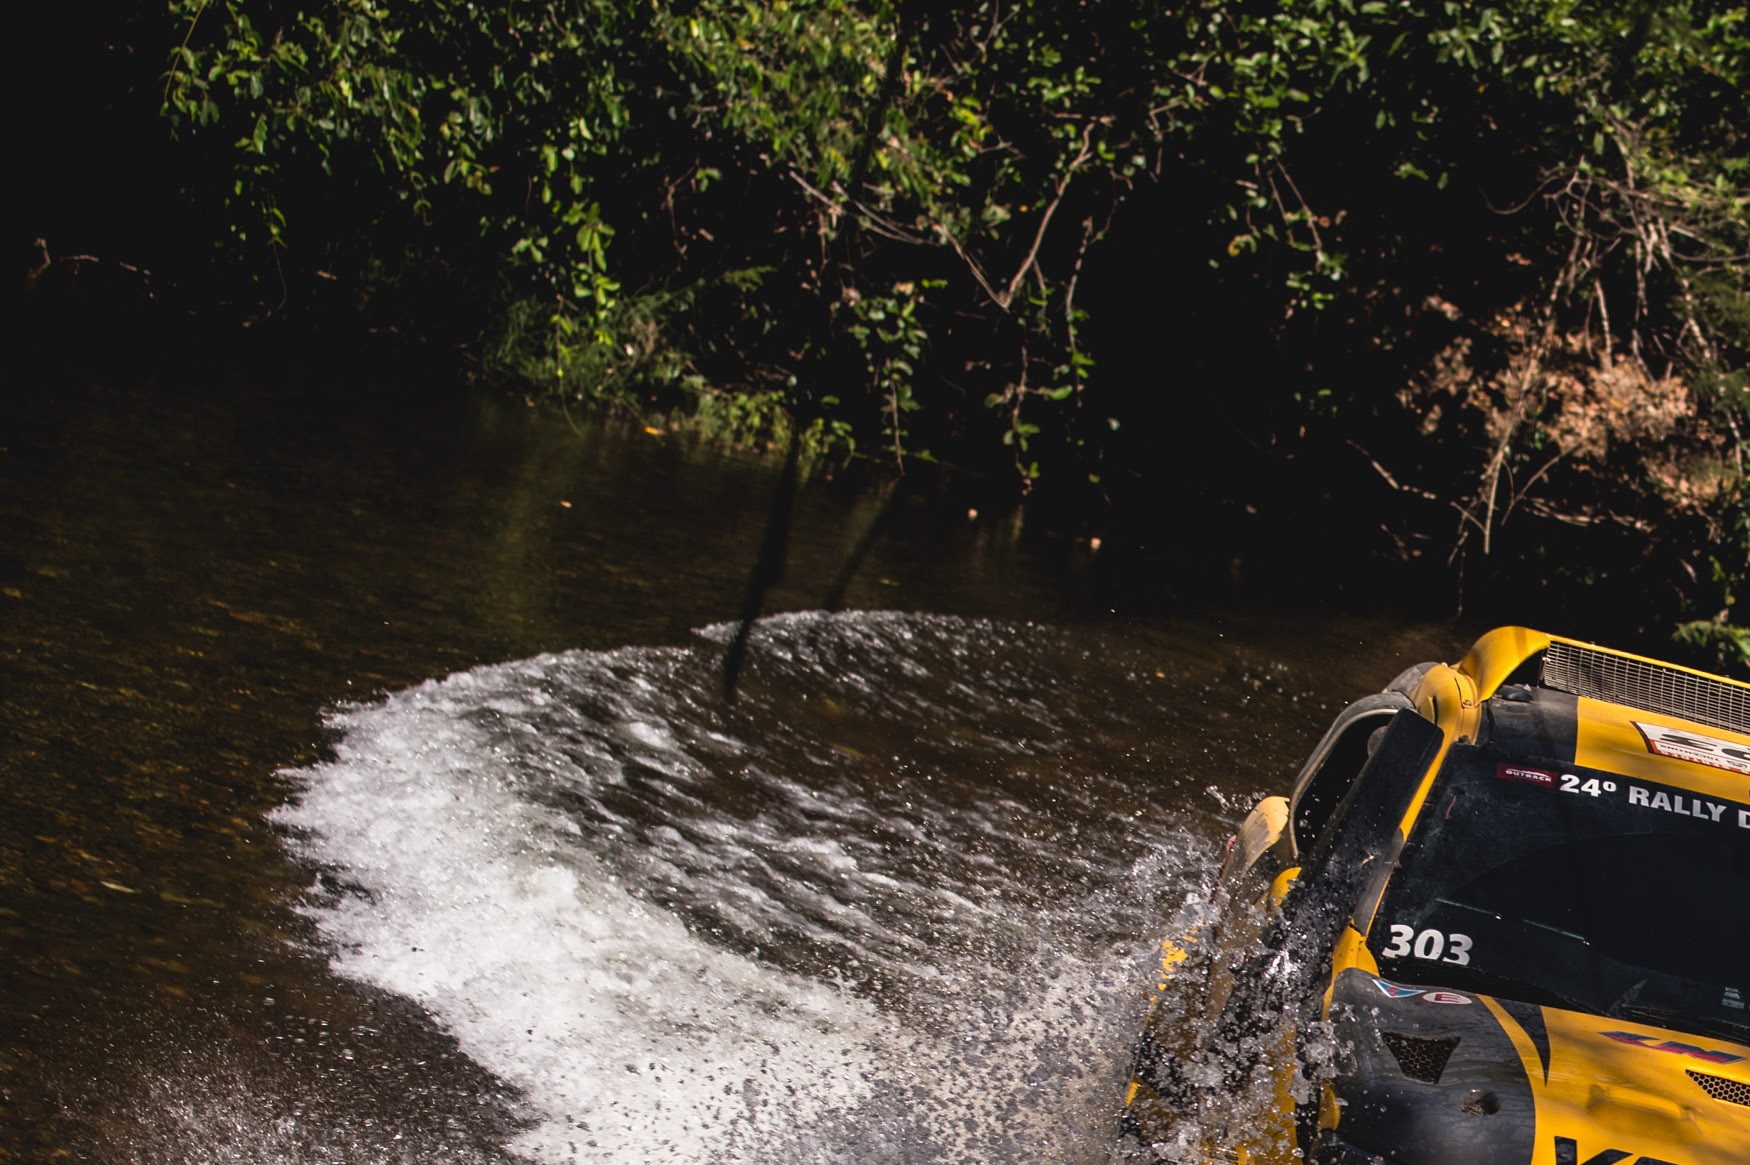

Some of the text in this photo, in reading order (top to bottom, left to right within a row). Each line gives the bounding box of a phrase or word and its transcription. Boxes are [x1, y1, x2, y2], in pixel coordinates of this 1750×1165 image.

[1504, 769, 1552, 783] OUTBACK
[1628, 785, 1727, 822] RALLY
[1381, 924, 1473, 966] 303
